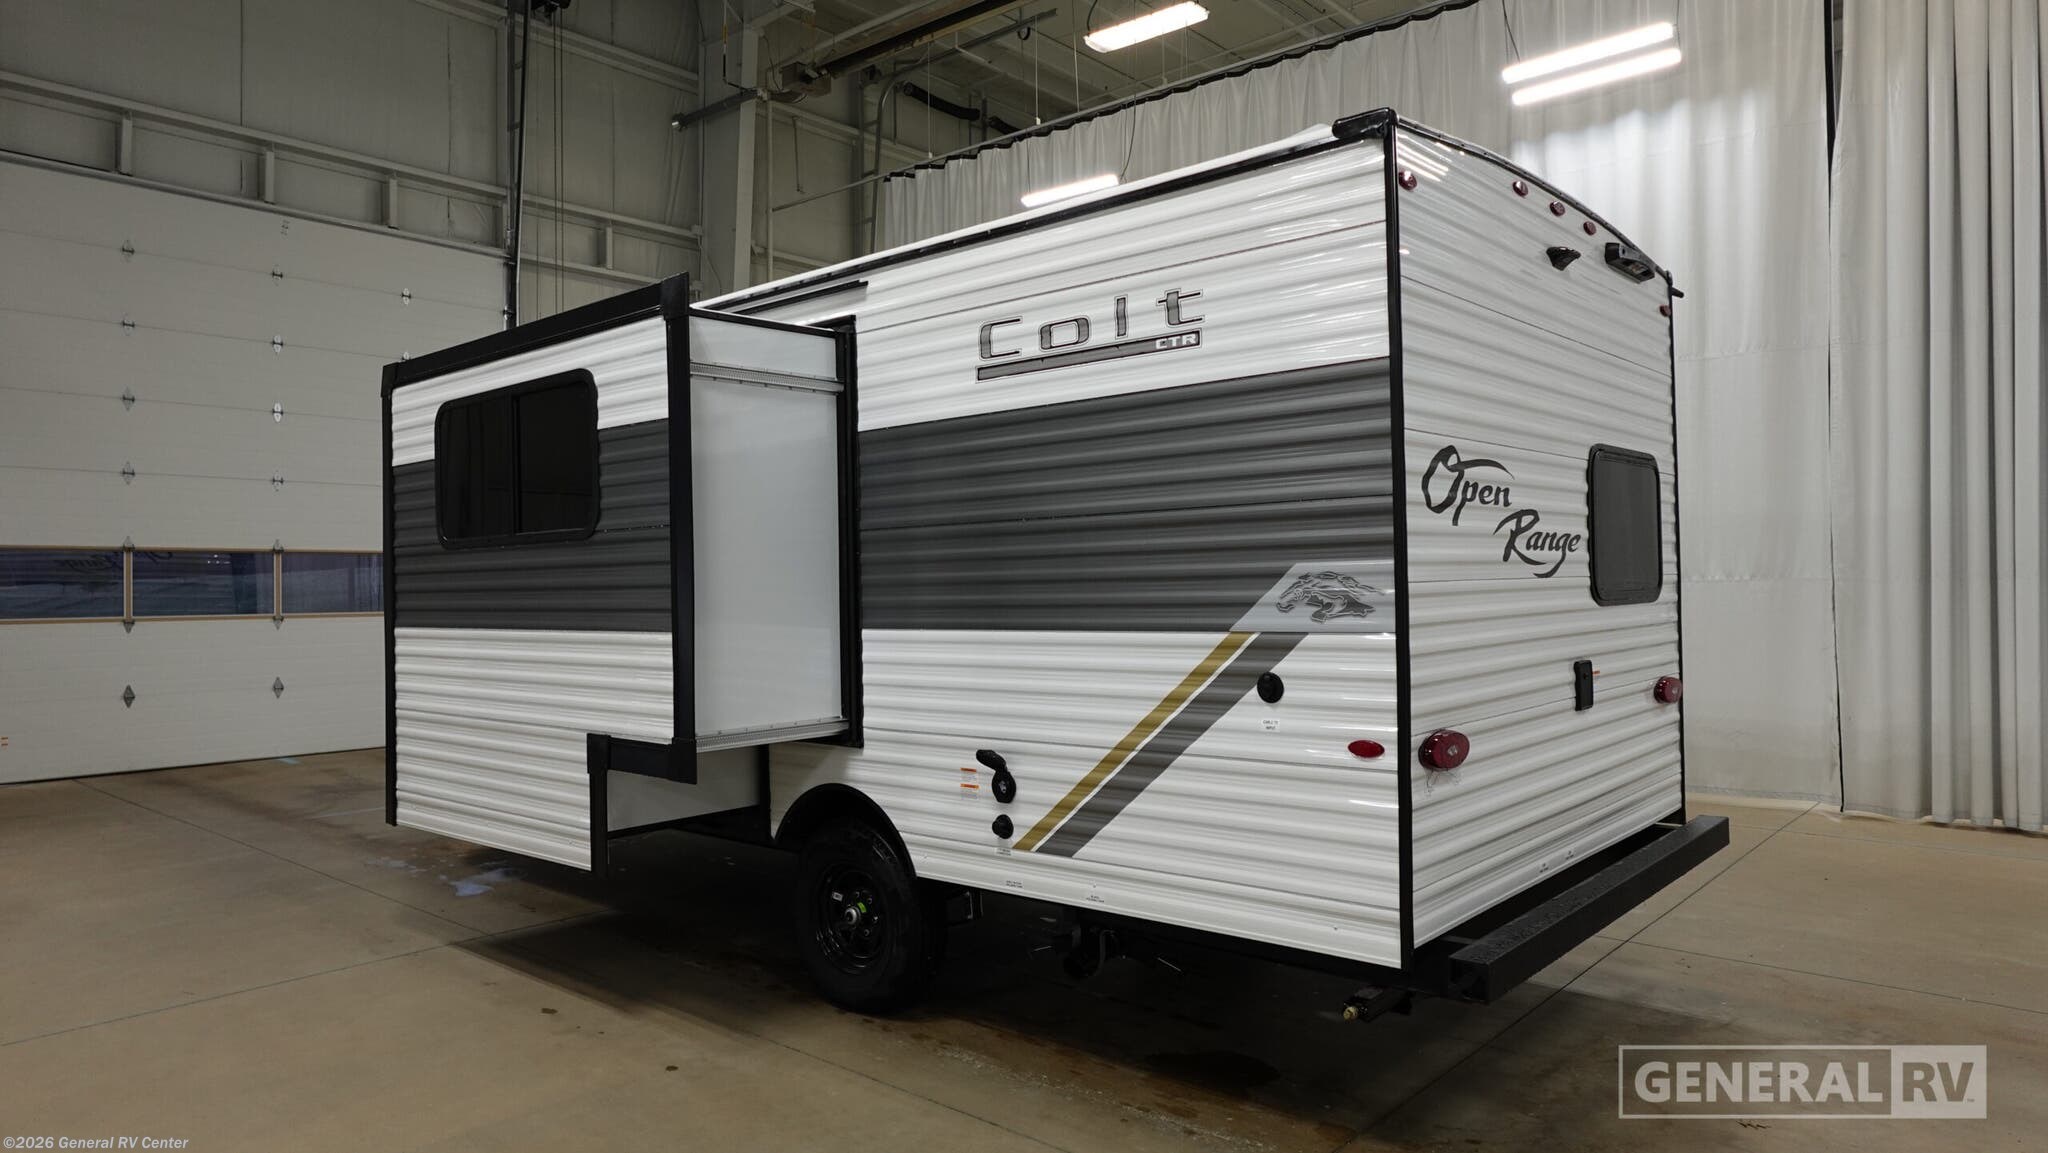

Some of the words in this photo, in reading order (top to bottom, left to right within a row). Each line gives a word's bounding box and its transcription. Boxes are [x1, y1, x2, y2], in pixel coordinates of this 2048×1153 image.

[979, 288, 1205, 360] Colt
[1155, 334, 1197, 350] CTR
[1421, 444, 1515, 526] Open
[1493, 509, 1582, 578] Range
